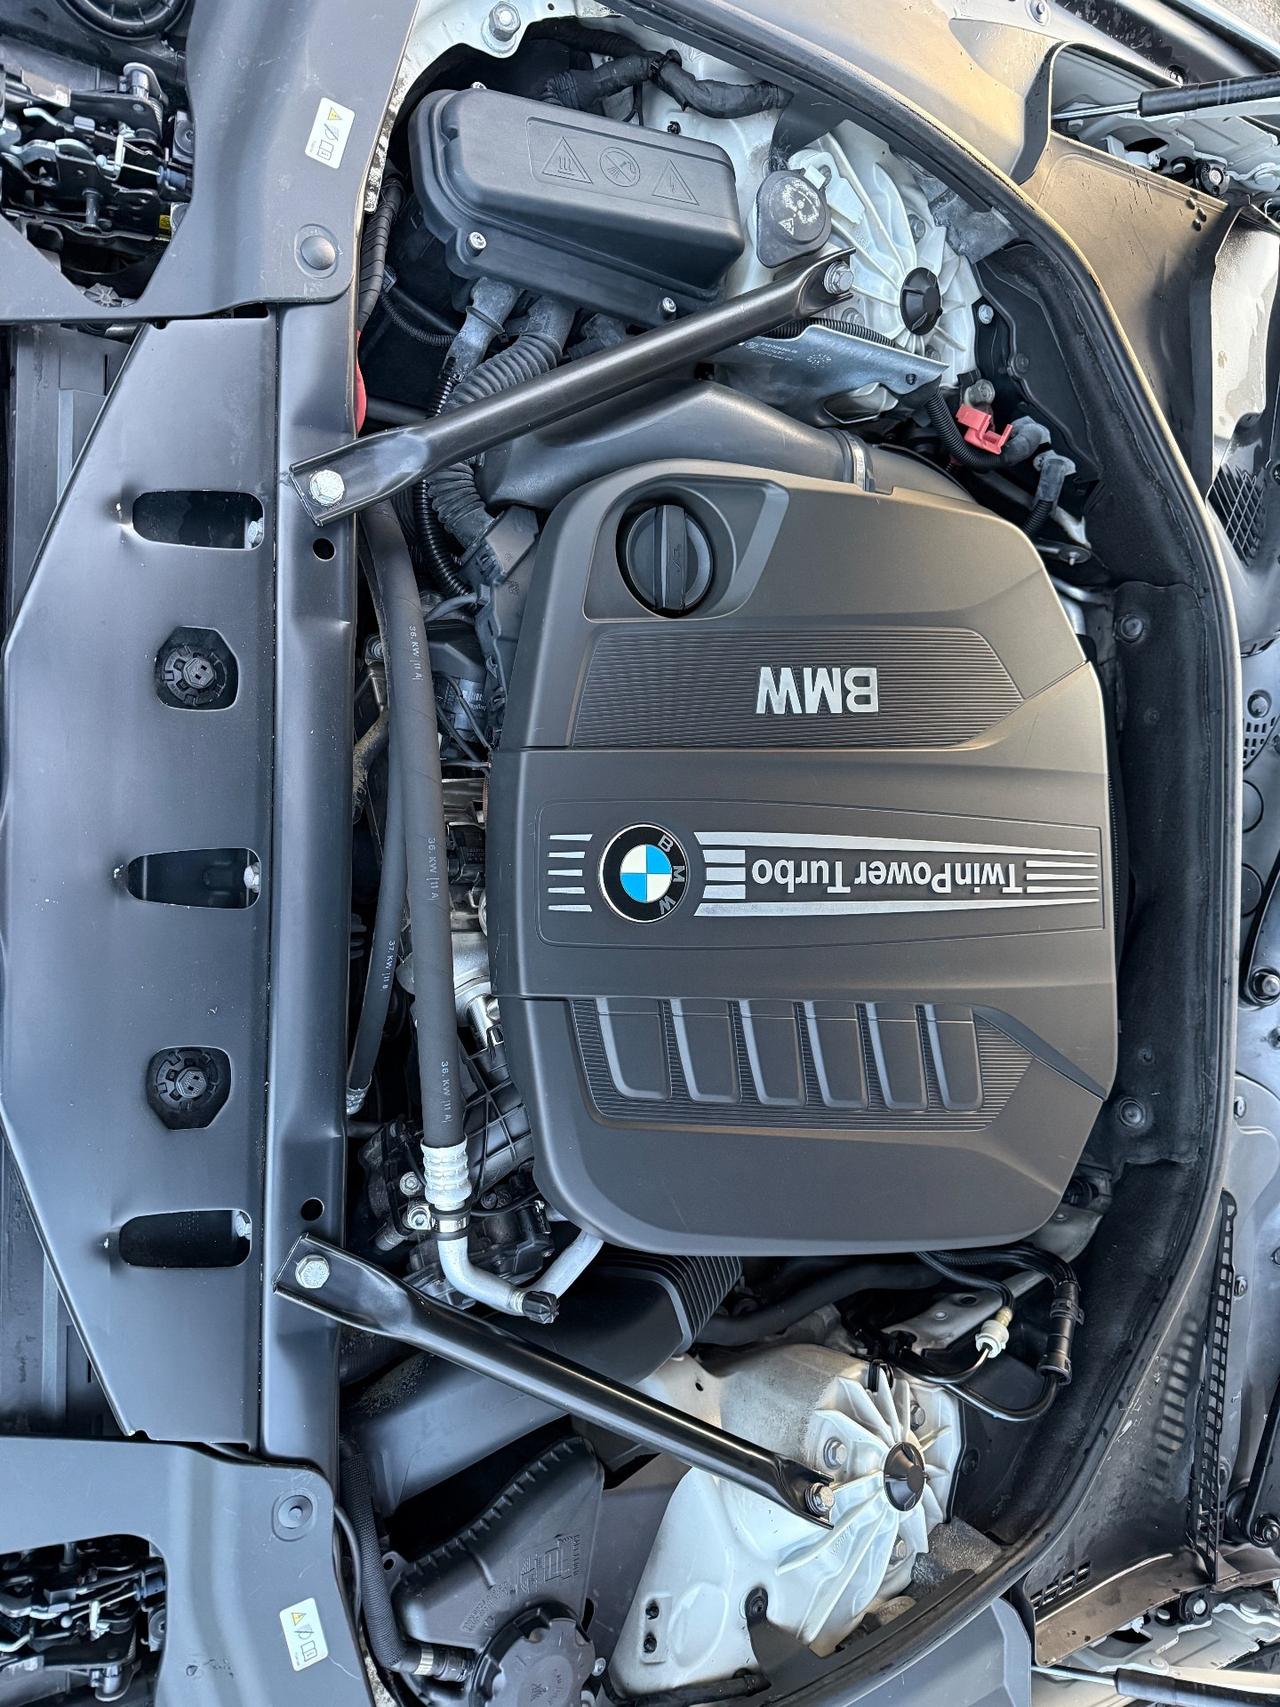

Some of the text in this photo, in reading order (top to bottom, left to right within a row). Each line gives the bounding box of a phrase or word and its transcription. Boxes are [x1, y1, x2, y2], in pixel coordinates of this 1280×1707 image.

[756, 667, 879, 715] BMW
[752, 858, 1023, 895] TwinPower Turbo
